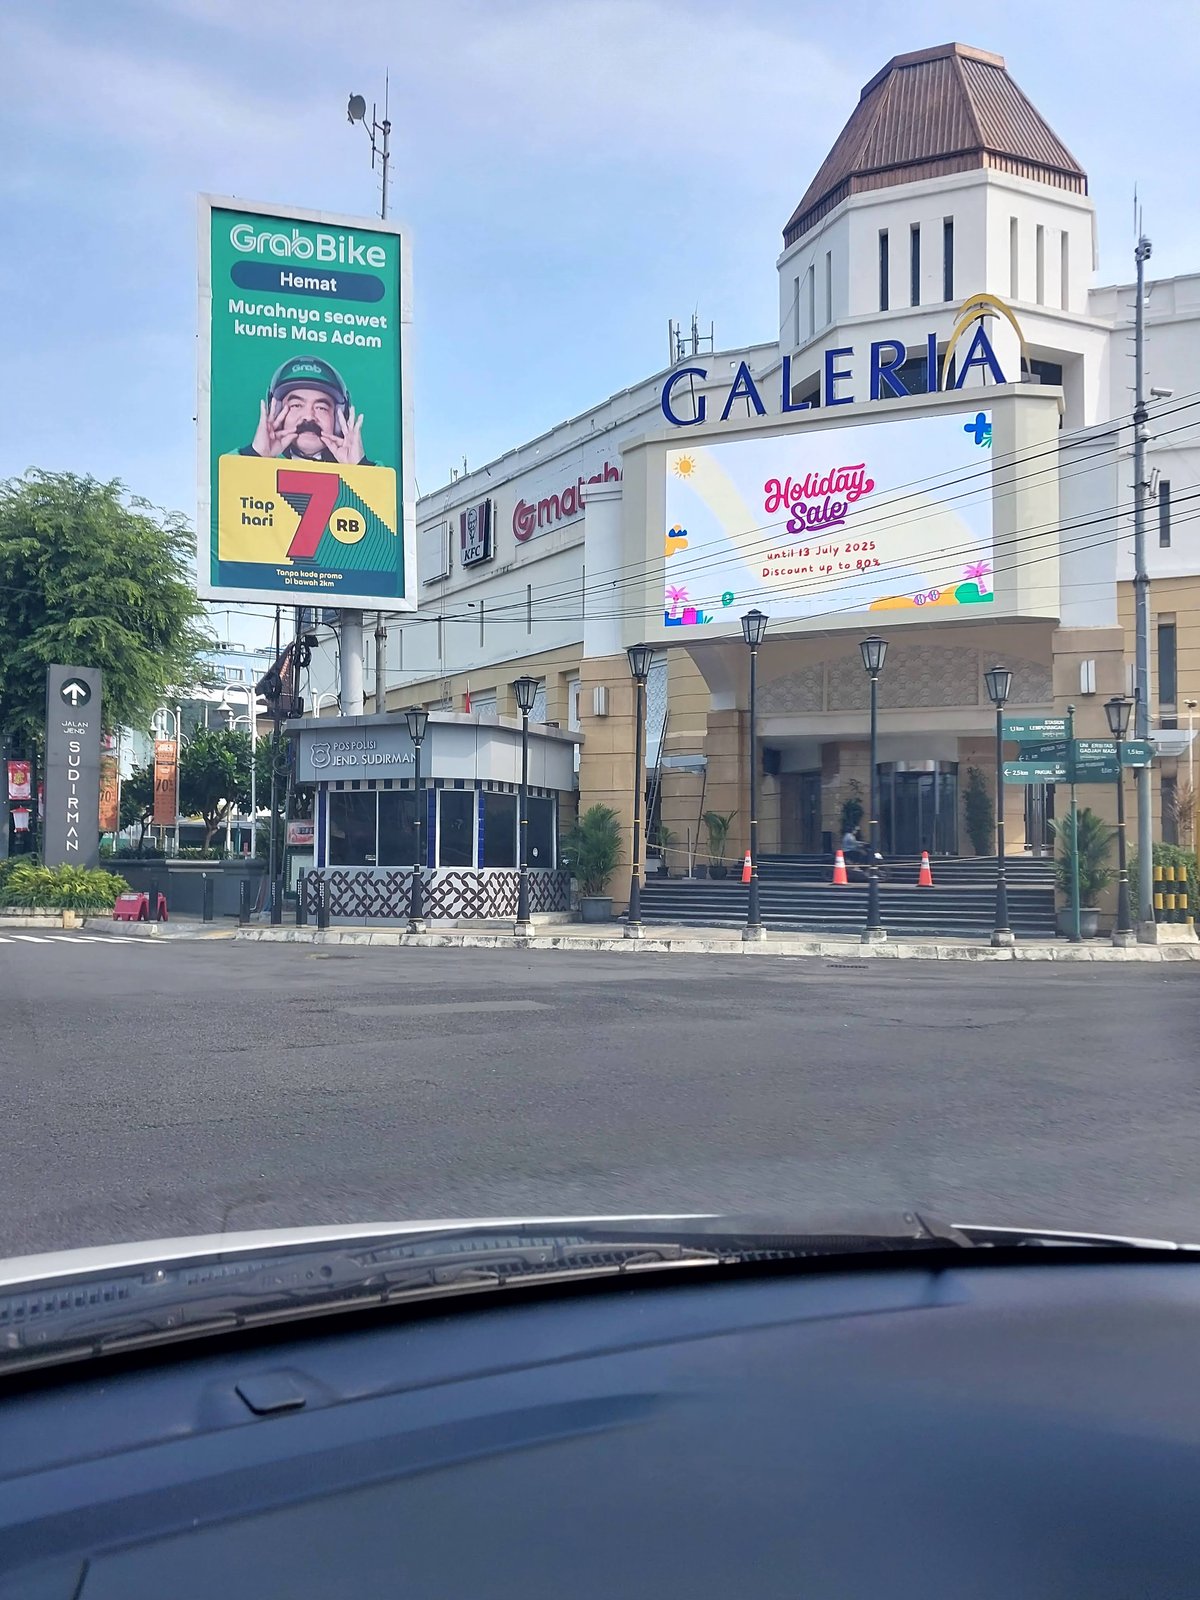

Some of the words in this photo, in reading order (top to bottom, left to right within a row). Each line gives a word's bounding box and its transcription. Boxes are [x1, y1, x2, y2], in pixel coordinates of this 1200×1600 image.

[280, 271, 337, 292] Hemat
[228, 299, 320, 323] Murahnya
[324, 312, 387, 329] seawet
[234, 320, 287, 339] kumis
[291, 326, 327, 342] Mas
[331, 330, 382, 348] Adam
[292, 364, 321, 373] Grab
[661, 324, 1007, 427] GALERIA
[764, 463, 875, 513] Holiday
[240, 497, 275, 513] Tiap
[277, 469, 340, 557] 7
[241, 513, 273, 526] hari
[786, 496, 848, 534] Sale
[336, 519, 359, 532] RB
[464, 545, 481, 562] KFC
[767, 549, 794, 560] until
[799, 547, 810, 556] 13
[816, 545, 839, 557] July
[845, 541, 876, 553] 2025
[276, 569, 299, 577] Tanpa
[300, 570, 318, 579] kode
[319, 572, 343, 580] promo
[762, 565, 813, 577] Discount
[820, 564, 832, 574] up
[839, 561, 850, 569] to
[856, 559, 880, 570] 80%
[294, 578, 318, 587] bawah
[61, 720, 89, 728] JALAN
[333, 742, 350, 751] POS
[351, 740, 376, 750] POLISI
[332, 755, 359, 766] JEND.
[66, 741, 80, 851] SUDIRMAN
